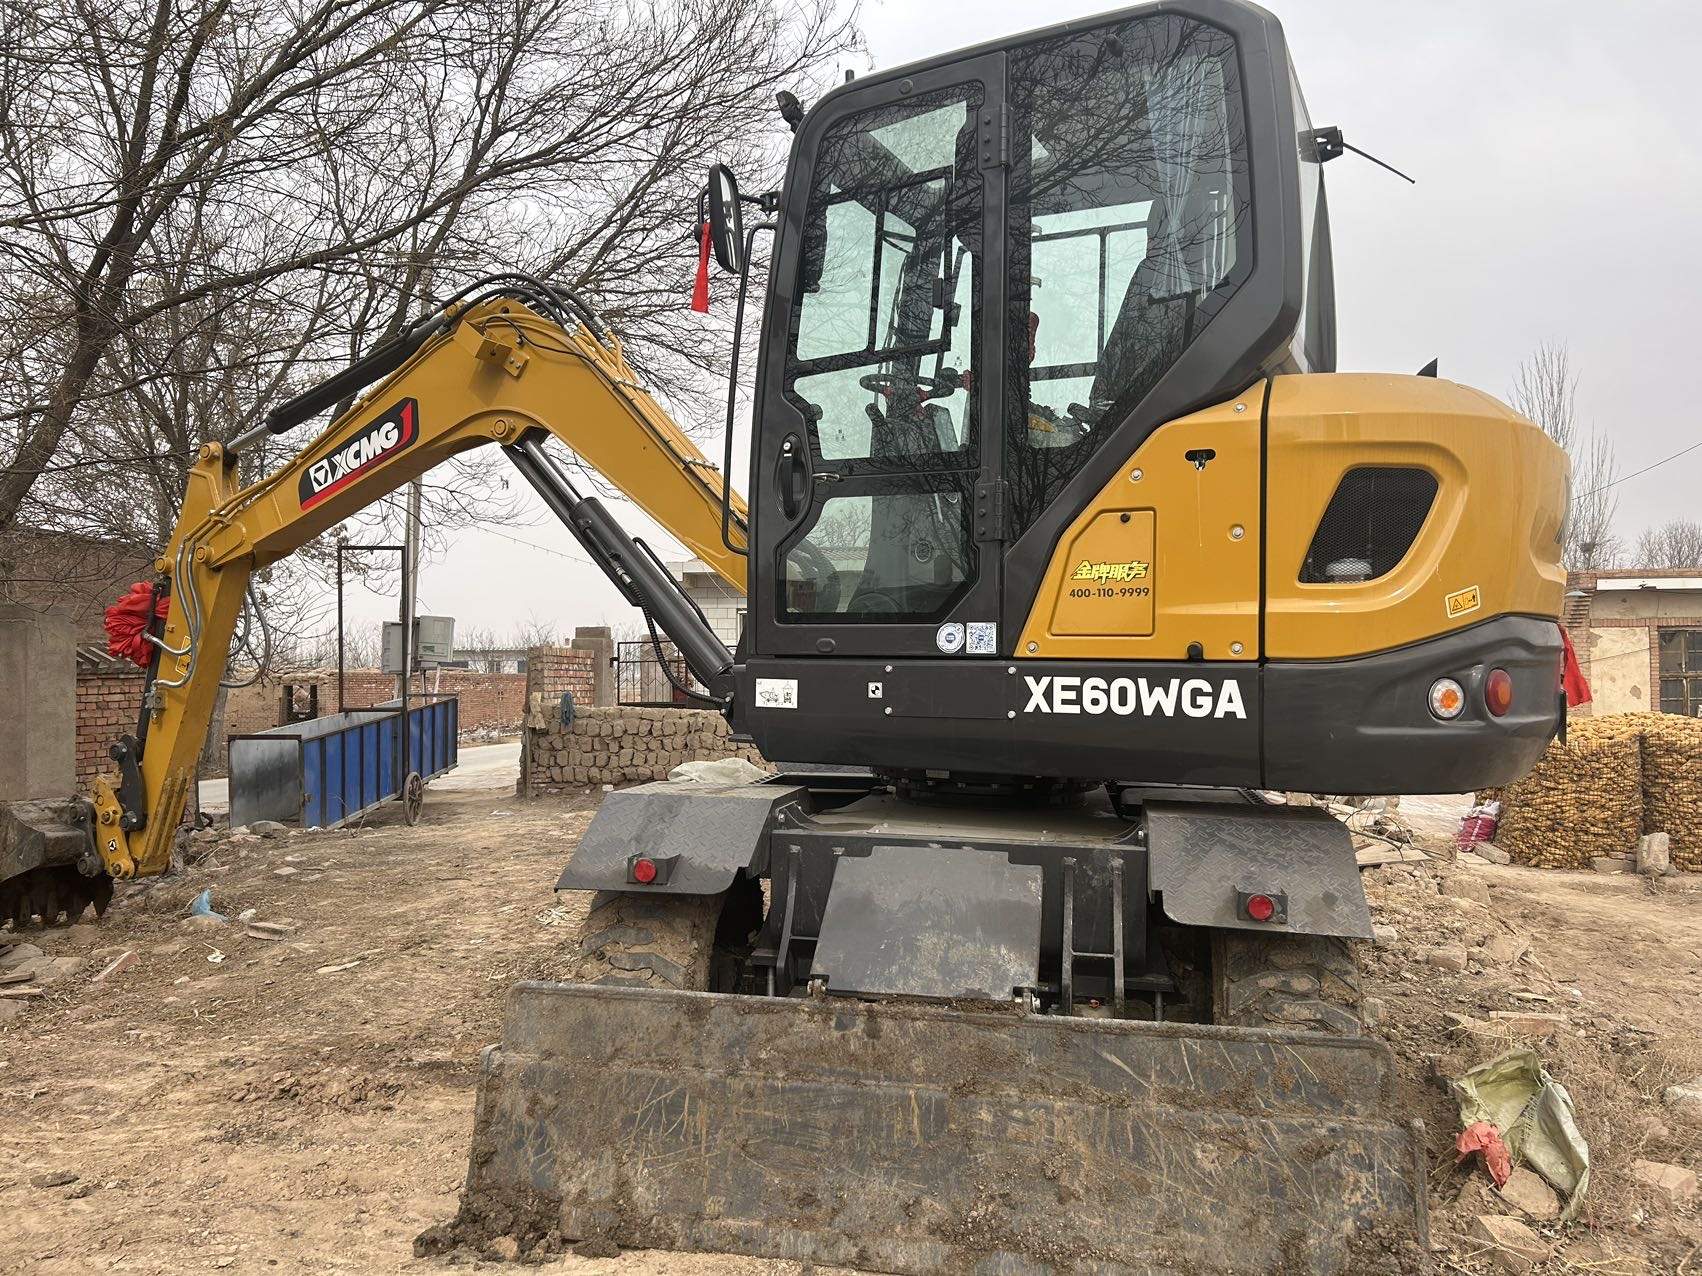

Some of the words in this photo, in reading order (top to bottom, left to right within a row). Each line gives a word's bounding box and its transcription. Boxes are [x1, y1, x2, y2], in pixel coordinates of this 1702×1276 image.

[331, 421, 399, 482] XCMG
[1071, 560, 1149, 585] 金牌服务
[1069, 587, 1149, 598] 400-110-9999
[1023, 676, 1247, 719] XE60WGA
